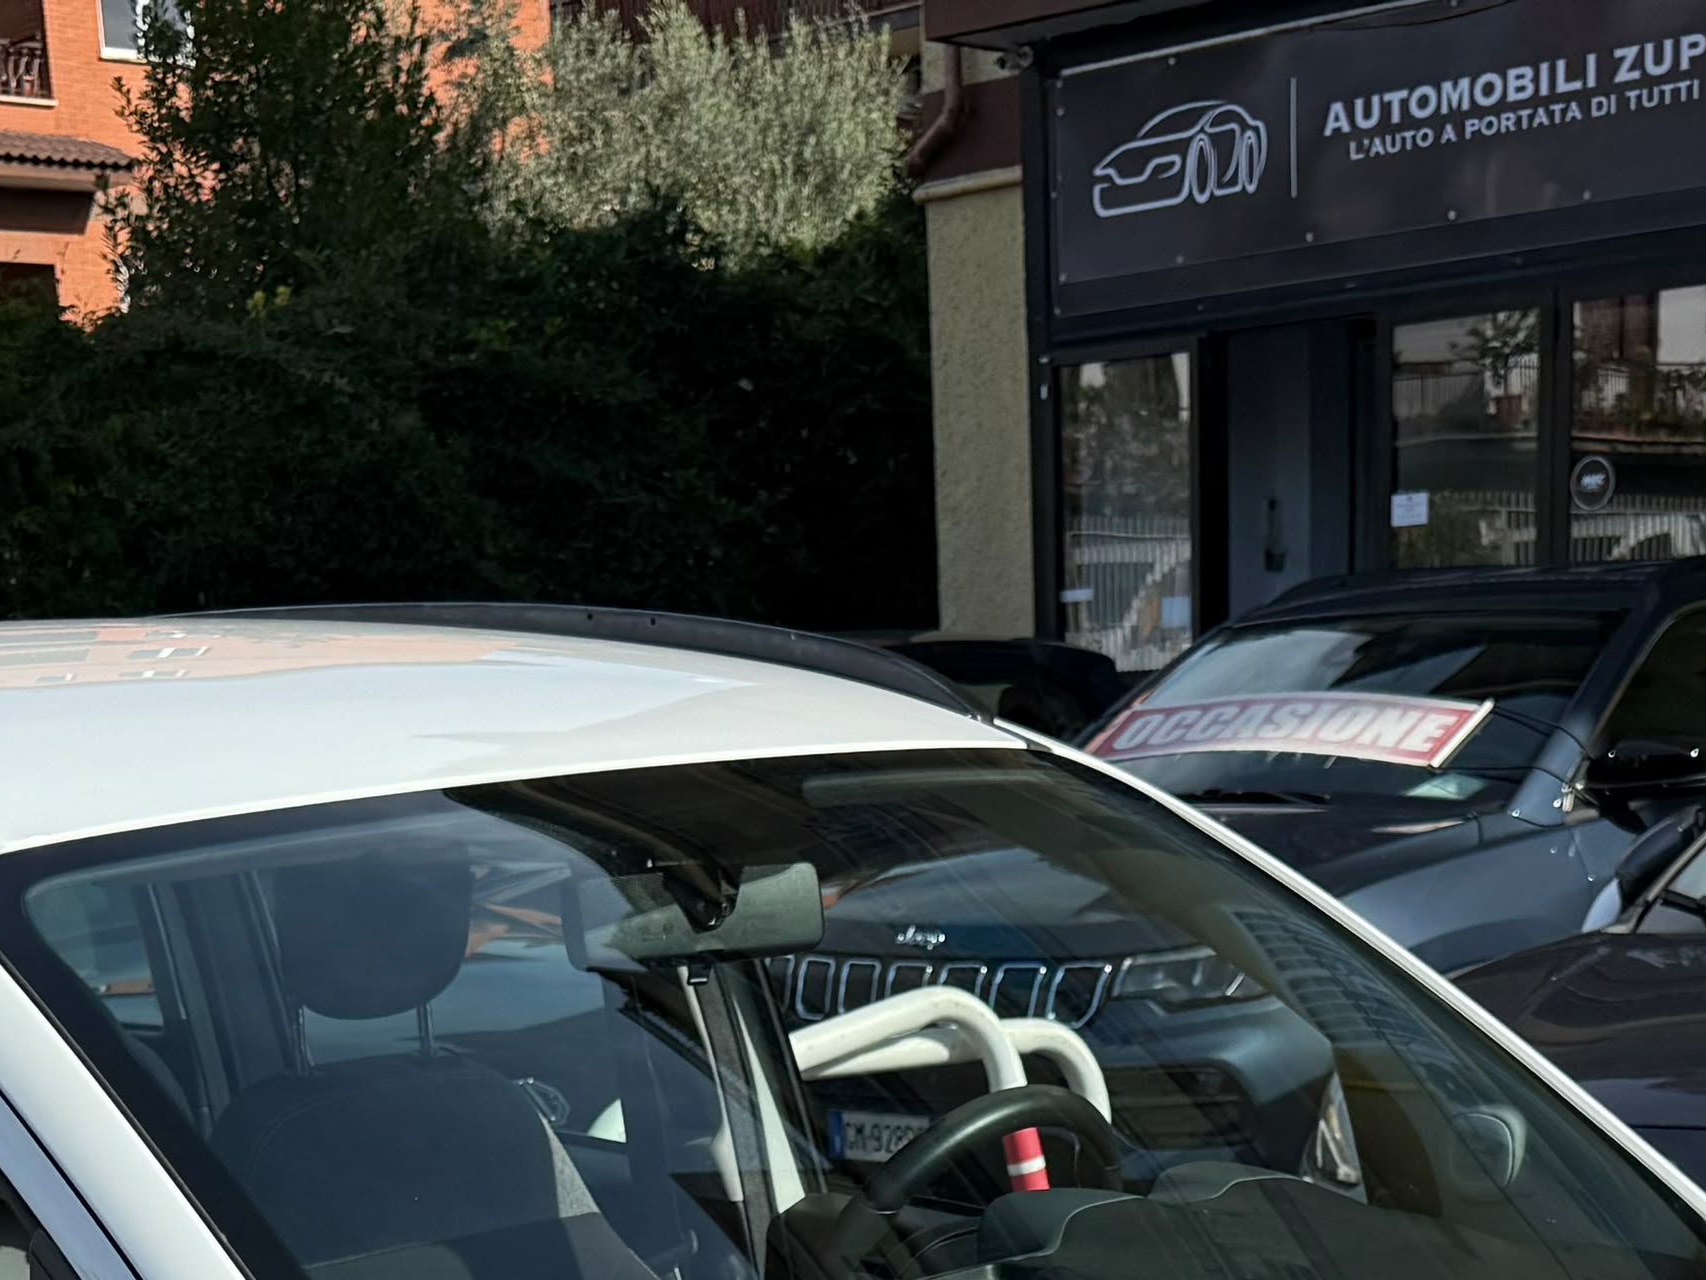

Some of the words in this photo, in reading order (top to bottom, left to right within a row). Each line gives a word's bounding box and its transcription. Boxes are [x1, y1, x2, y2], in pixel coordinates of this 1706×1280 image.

[1323, 53, 1597, 136] AUTOMOBILI
[1350, 129, 1434, 160] L'AUTO
[1441, 124, 1457, 144] A
[1465, 102, 1583, 140] PORTATA
[1592, 94, 1617, 118] DI
[1625, 79, 1700, 111] TUTTI
[1111, 703, 1461, 753] OCCASIONE
